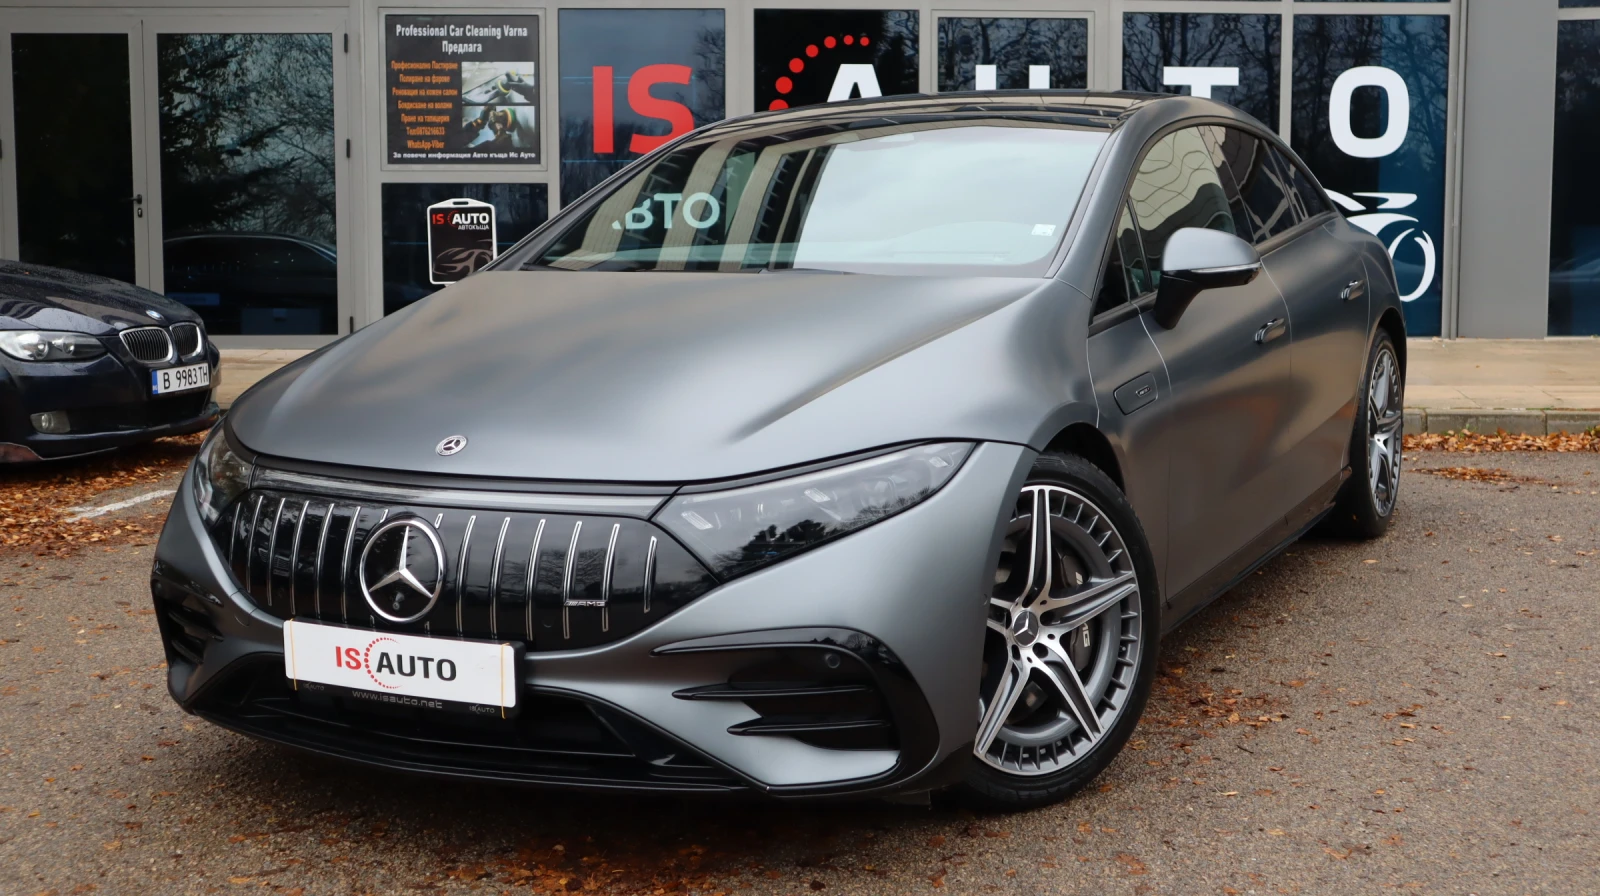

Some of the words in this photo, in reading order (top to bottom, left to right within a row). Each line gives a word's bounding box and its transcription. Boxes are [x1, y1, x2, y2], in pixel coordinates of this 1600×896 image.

[396, 24, 447, 37] Professional
[449, 24, 464, 37] Car
[465, 24, 502, 39] Cleaning
[503, 24, 528, 37] Varna
[442, 40, 482, 55] Предлага
[592, 63, 695, 154] IS
[432, 213, 444, 225] IS
[452, 213, 489, 224] AUTO
[163, 372, 171, 390] B
[176, 367, 198, 388] 9983
[198, 366, 209, 384] TH
[335, 646, 362, 670] IS
[376, 652, 457, 682] AUTO
[352, 690, 443, 709] www.isauto.net
